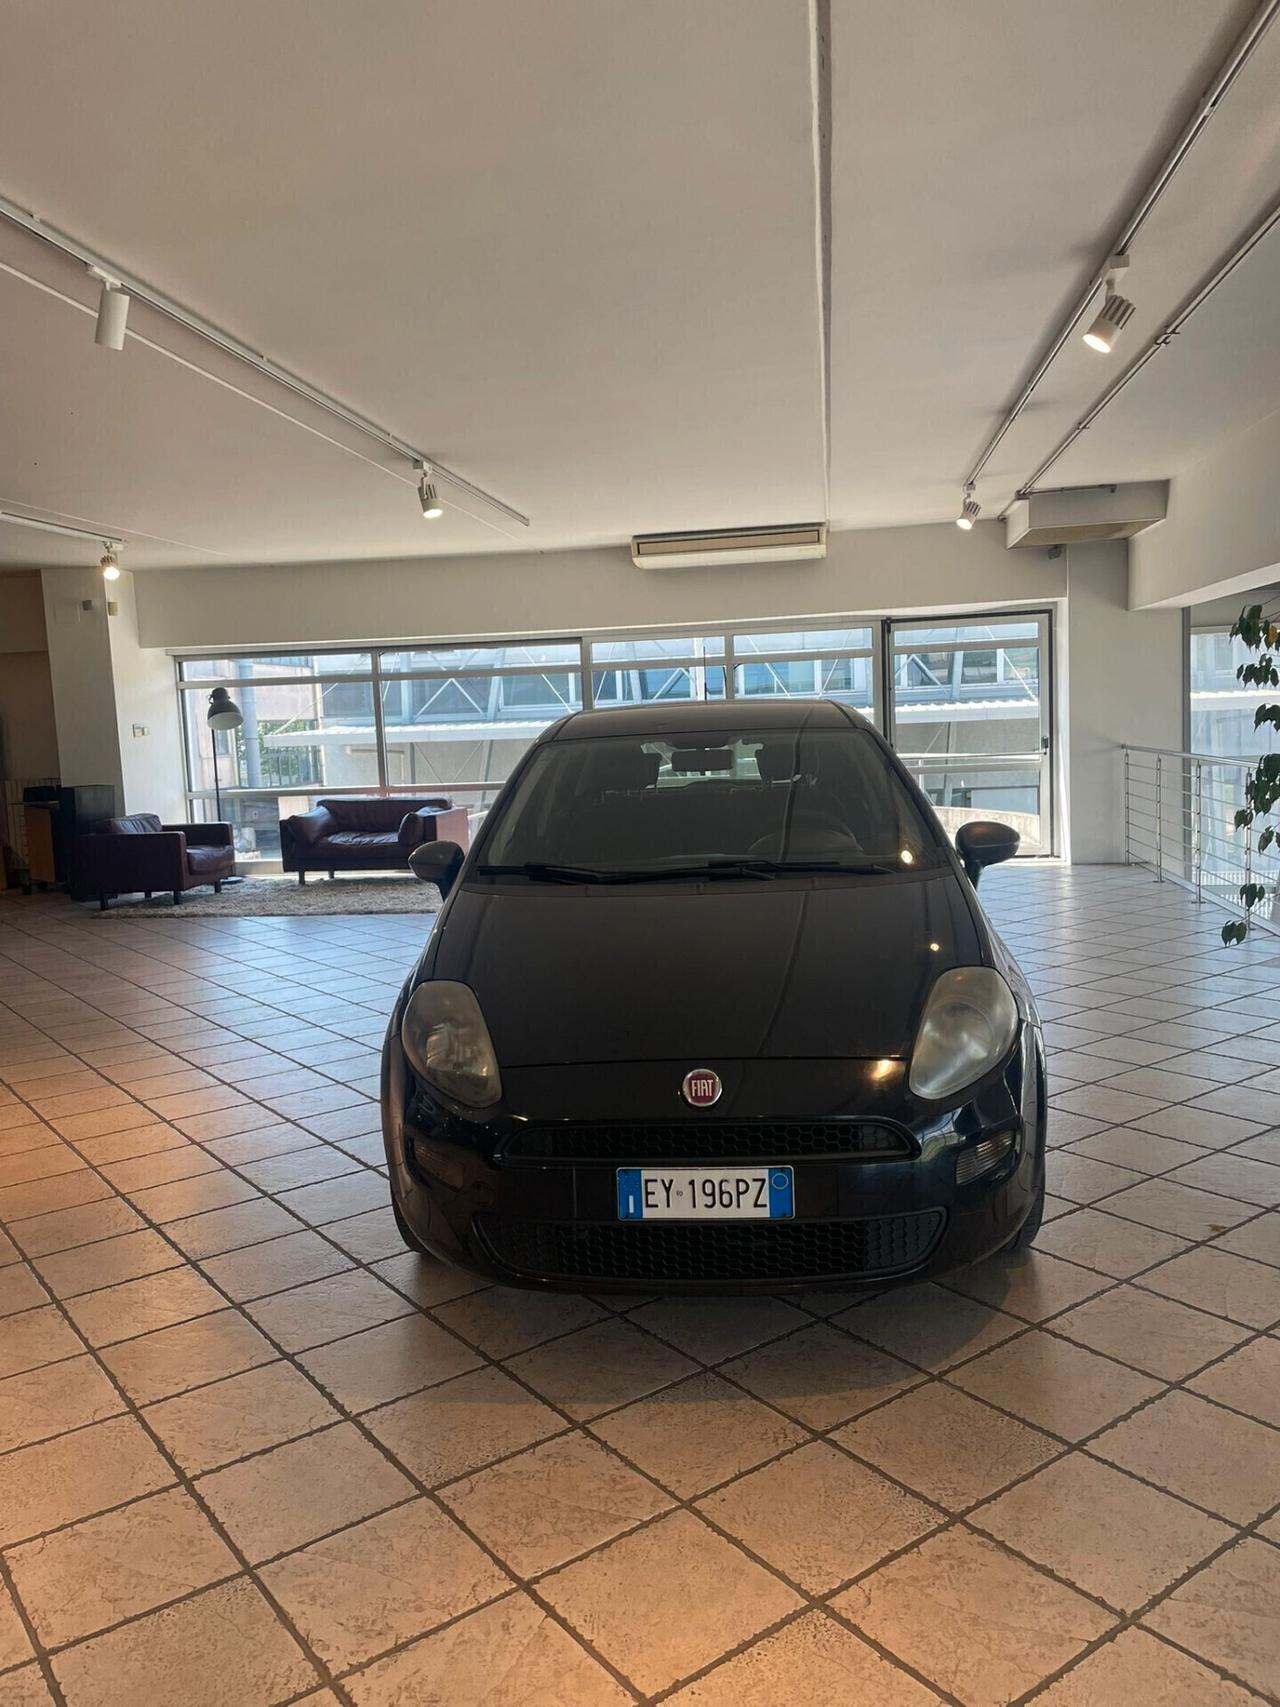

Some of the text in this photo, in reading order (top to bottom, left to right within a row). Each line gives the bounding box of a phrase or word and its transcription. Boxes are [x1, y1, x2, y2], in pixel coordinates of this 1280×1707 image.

[691, 1079, 714, 1097] FIAT
[644, 1178, 768, 1208] EY 196PZ
